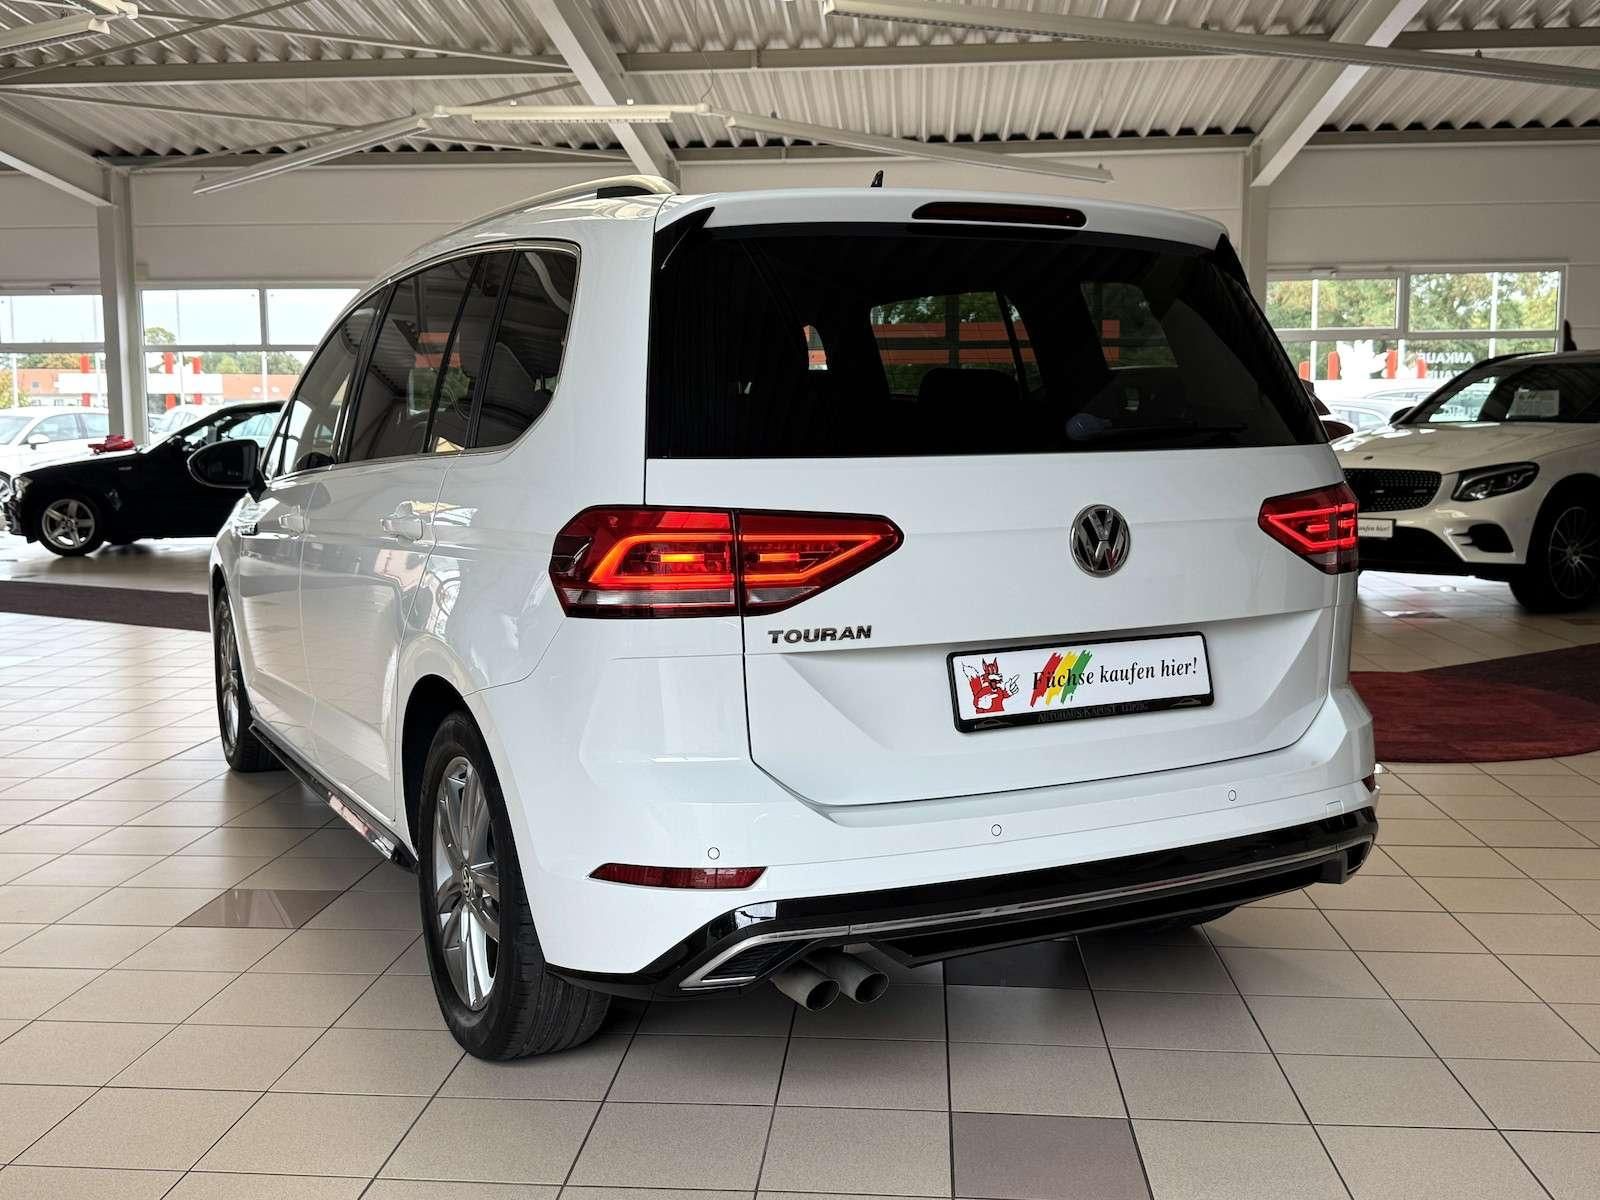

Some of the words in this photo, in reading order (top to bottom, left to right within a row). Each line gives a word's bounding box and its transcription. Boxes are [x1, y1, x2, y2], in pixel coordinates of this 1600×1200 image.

[767, 624, 873, 645] TOURAN
[1032, 667, 1094, 690] Füchse
[1099, 661, 1155, 685] kaufen
[1160, 656, 1197, 677] hier!
